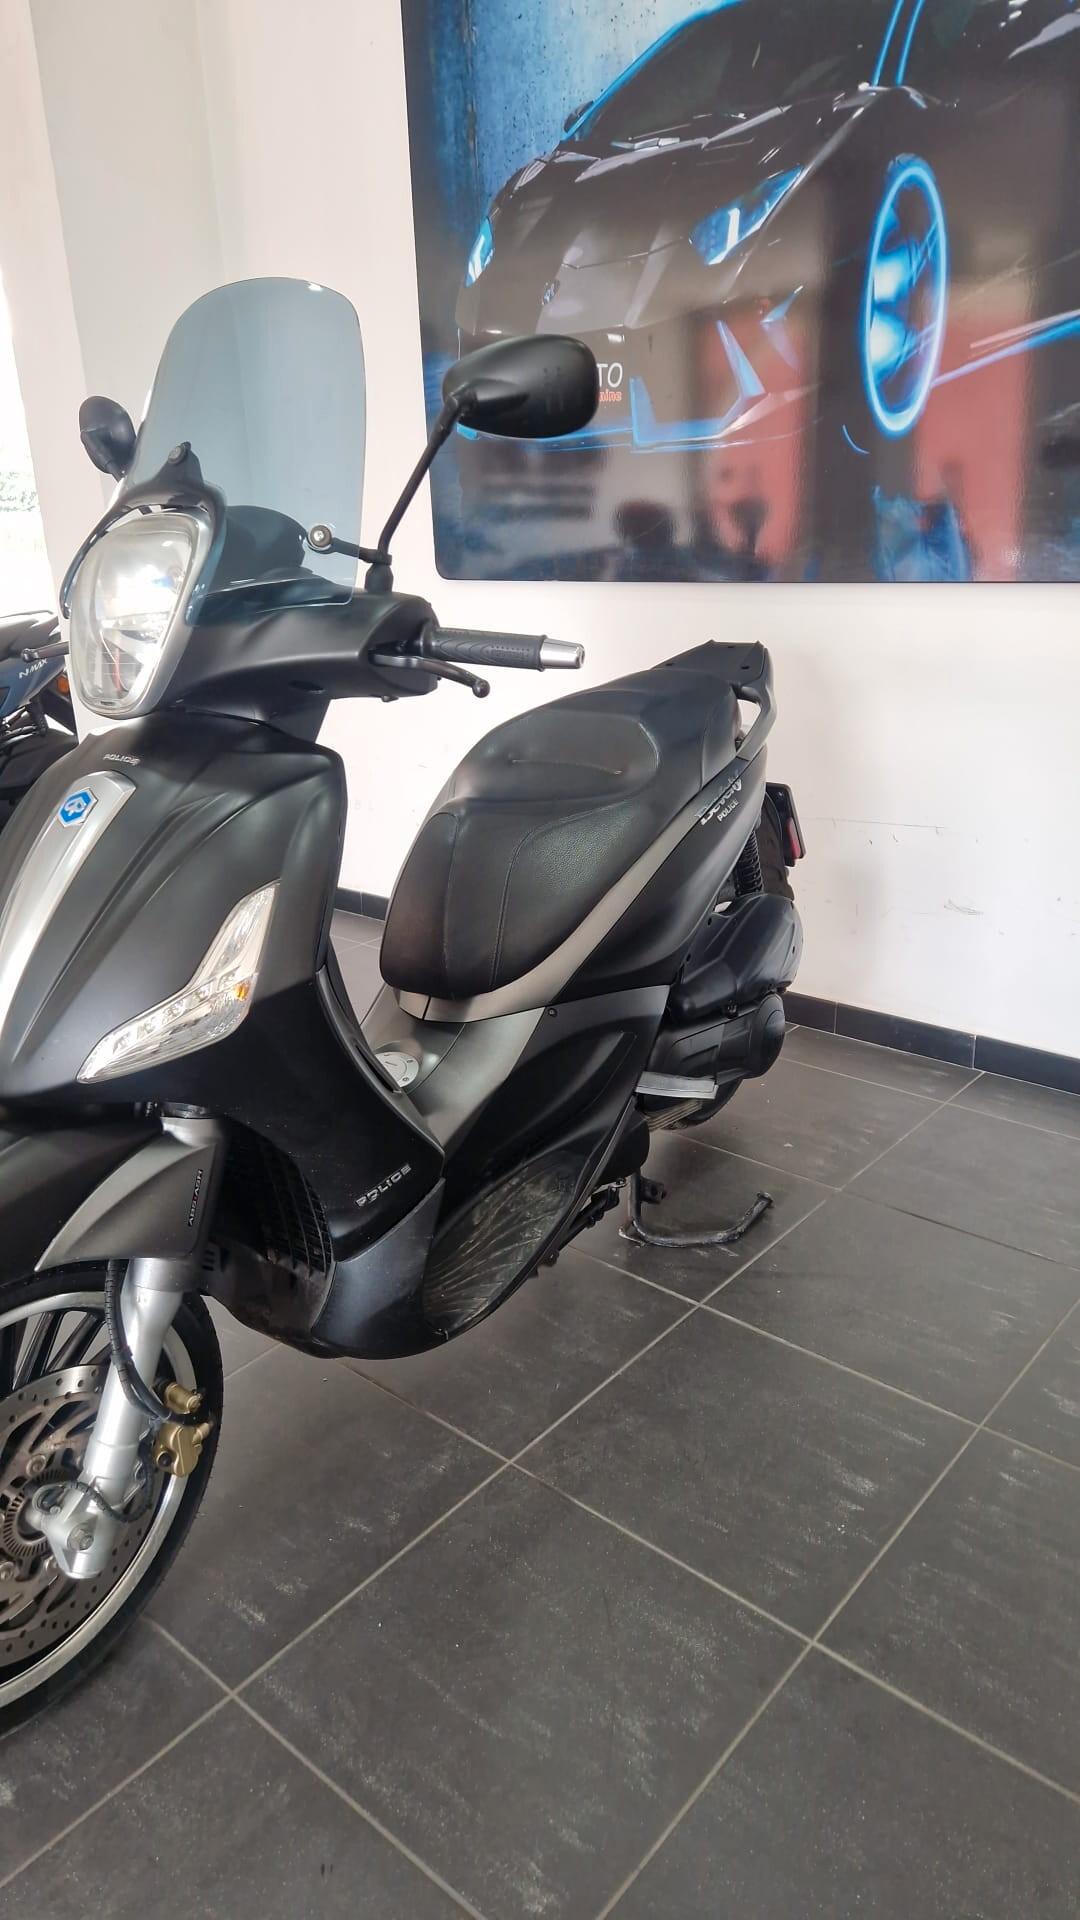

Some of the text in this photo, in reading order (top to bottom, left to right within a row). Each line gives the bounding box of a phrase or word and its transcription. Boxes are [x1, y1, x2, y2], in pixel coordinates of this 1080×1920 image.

[596, 362, 623, 388] TO
[103, 753, 140, 766] POLICE
[716, 798, 739, 822] POLICE
[355, 1164, 411, 1207] POLICE
